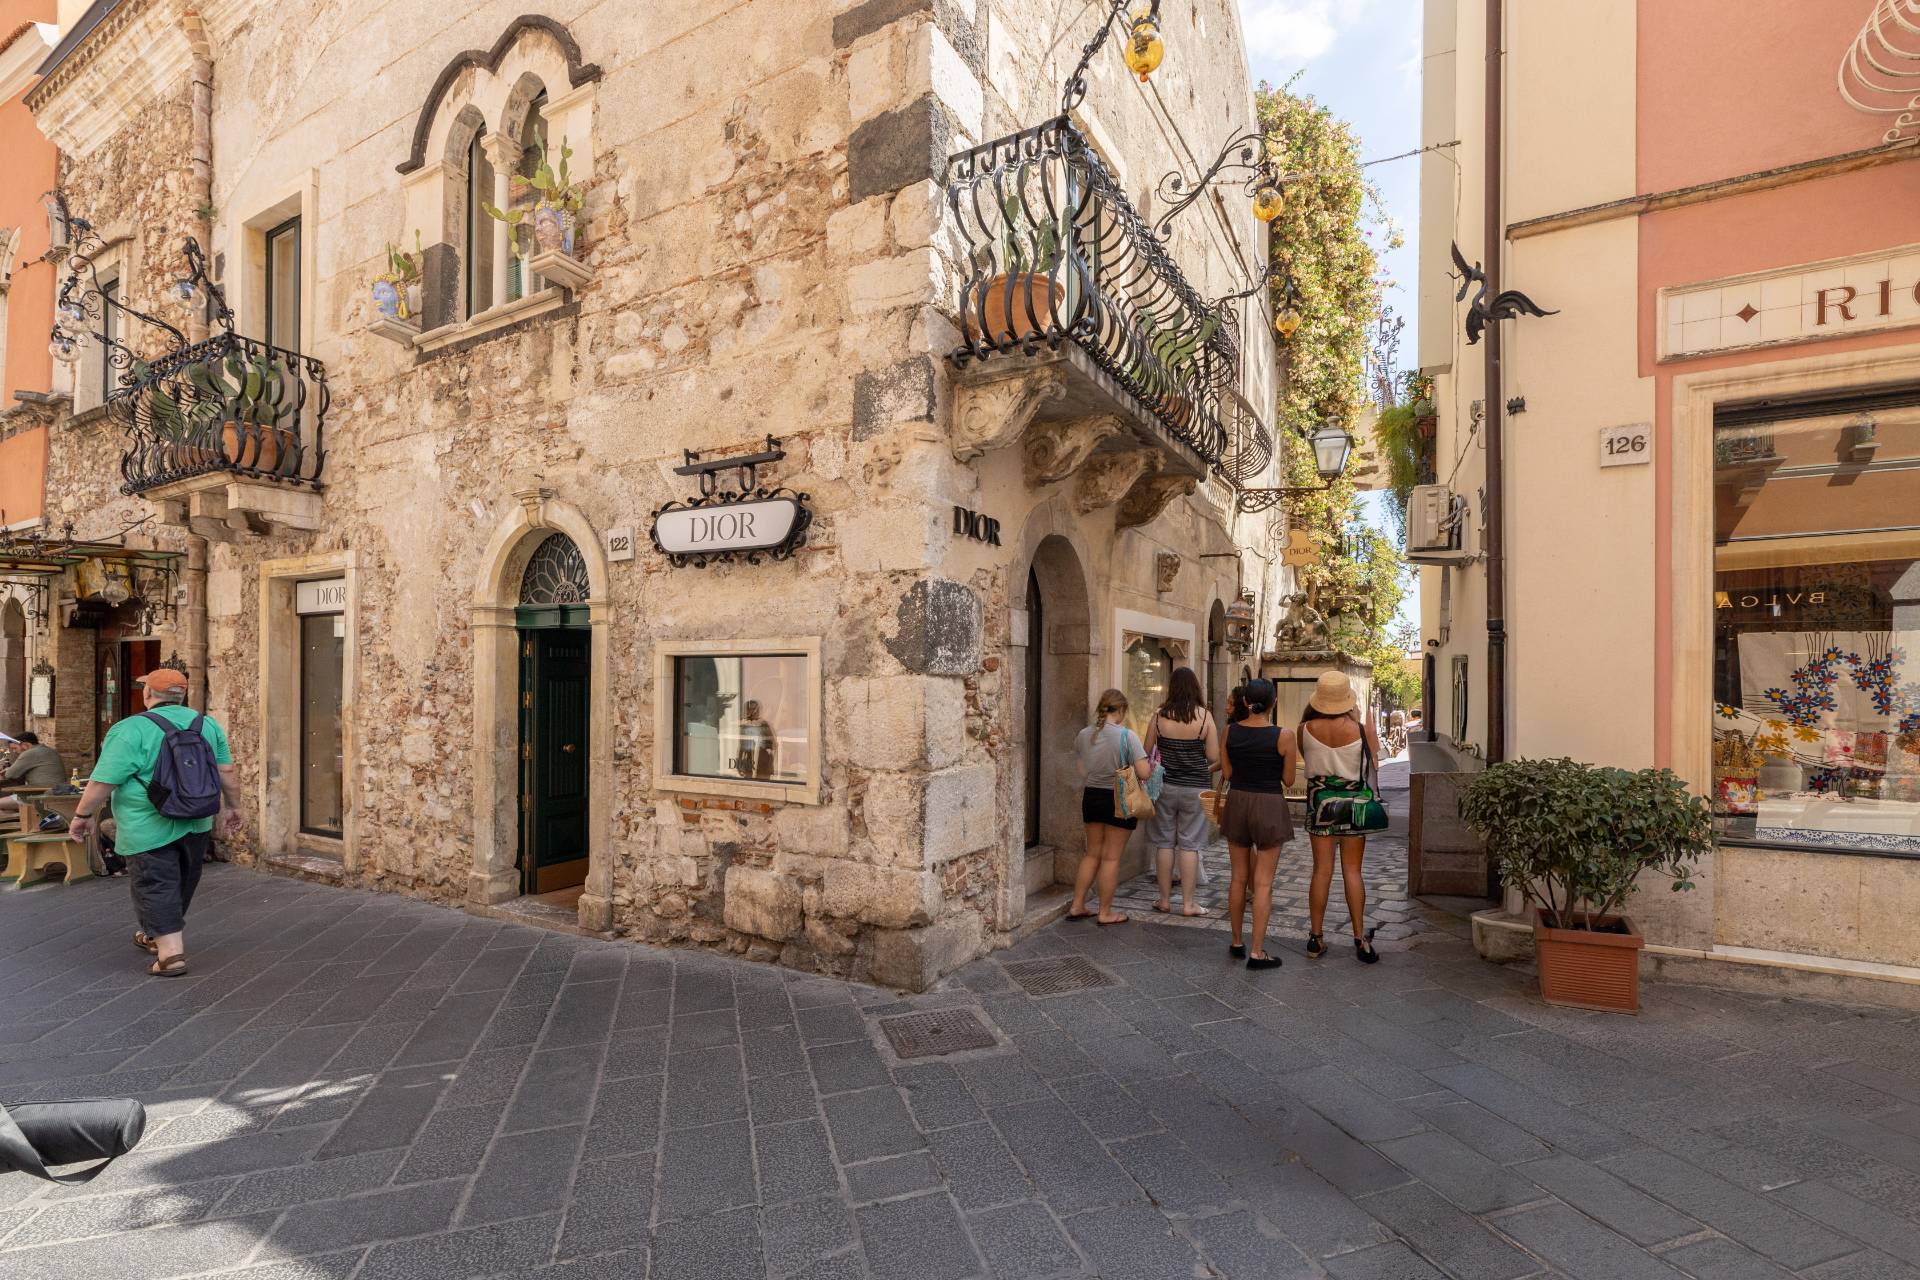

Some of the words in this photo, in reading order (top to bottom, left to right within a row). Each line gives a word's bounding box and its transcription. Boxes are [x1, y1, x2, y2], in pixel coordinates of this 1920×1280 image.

[1814, 279, 1920, 326] RI
[1606, 435, 1647, 455] 126
[689, 512, 757, 543] DIOR
[952, 505, 1002, 547] DIOR
[609, 536, 630, 551] 122
[1289, 547, 1312, 556] DIOR
[316, 586, 346, 606] DIOR
